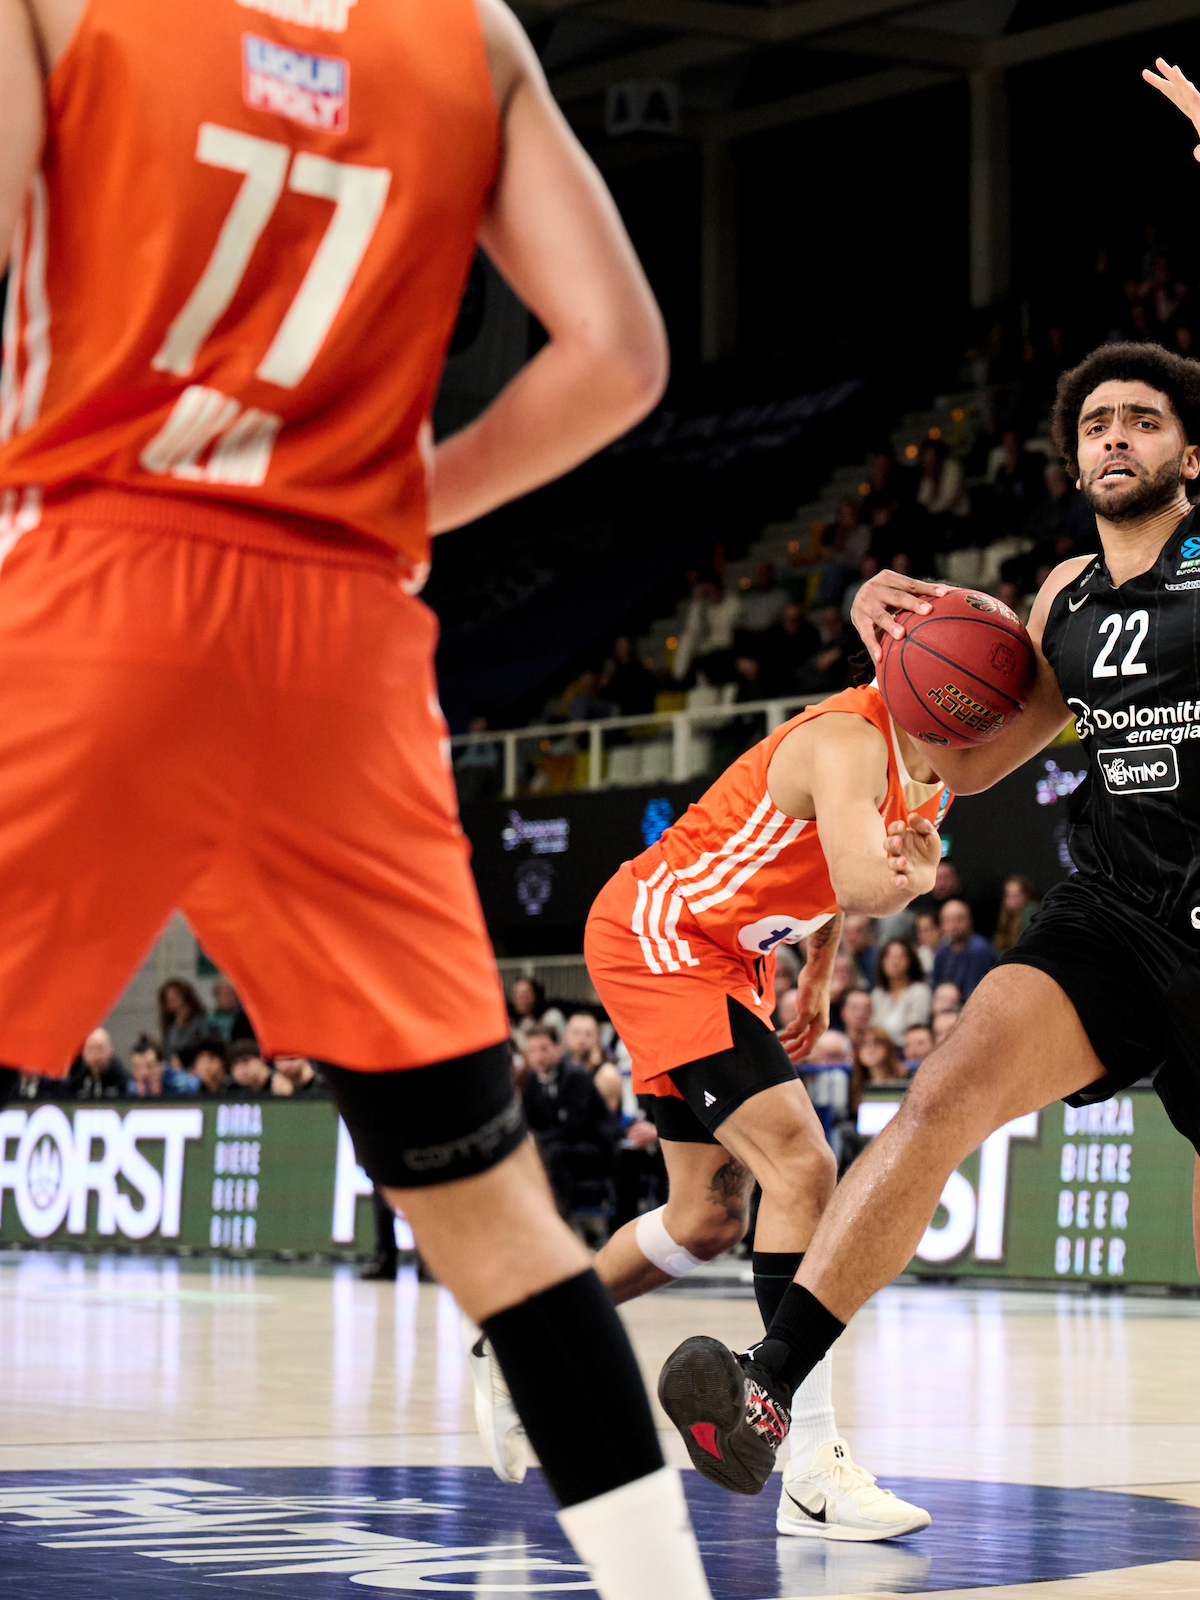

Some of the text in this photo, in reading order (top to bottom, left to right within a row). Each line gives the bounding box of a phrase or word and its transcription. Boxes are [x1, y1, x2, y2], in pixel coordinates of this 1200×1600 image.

[152, 122, 391, 389] 77
[1092, 609, 1149, 678] 22
[926, 687, 1003, 735] LEGACY
[1103, 759, 1168, 786] TRENTINO
[1057, 1189, 1129, 1230] BEER
[1054, 1235, 1127, 1276] BIER
